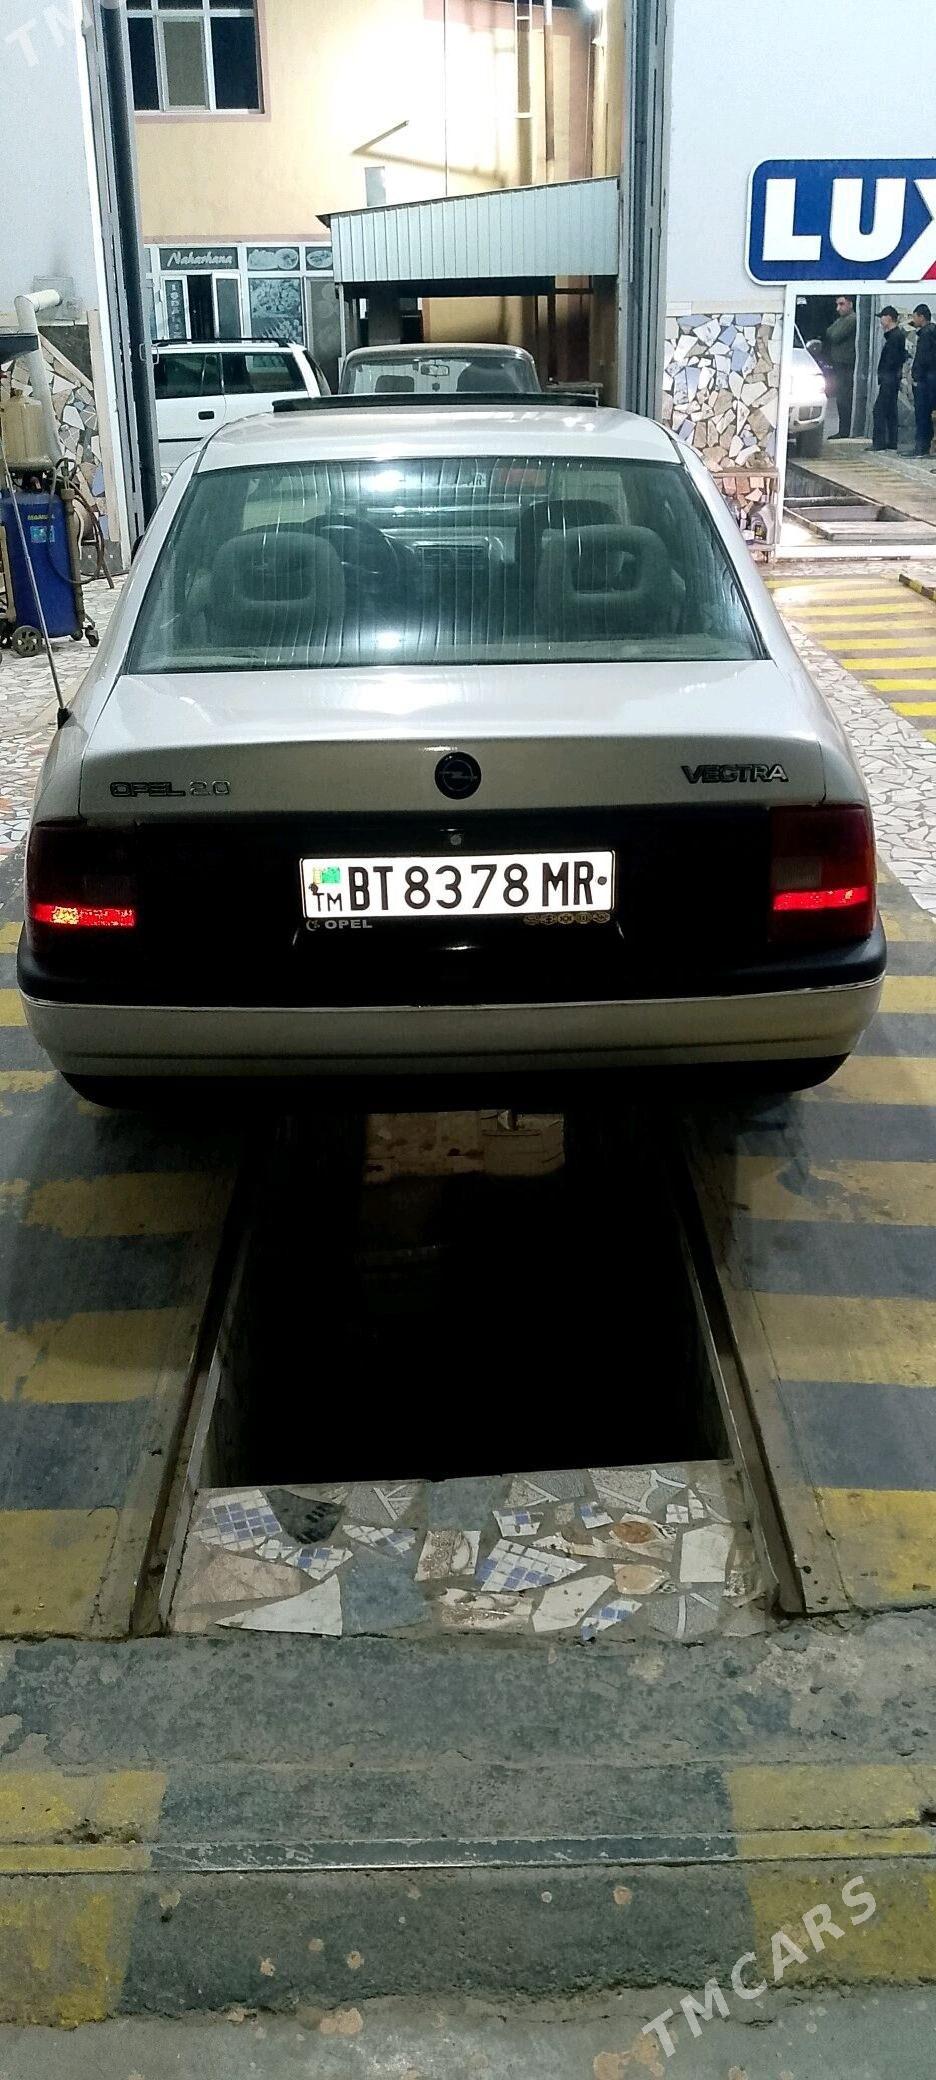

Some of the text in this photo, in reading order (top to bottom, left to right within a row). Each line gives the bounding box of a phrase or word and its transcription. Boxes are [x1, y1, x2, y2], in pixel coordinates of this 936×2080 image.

[681, 764, 790, 784] VECTRA
[110, 781, 186, 797] OPEL
[541, 861, 594, 907] MR
[313, 893, 343, 912] TM
[324, 919, 373, 929] OPEL
